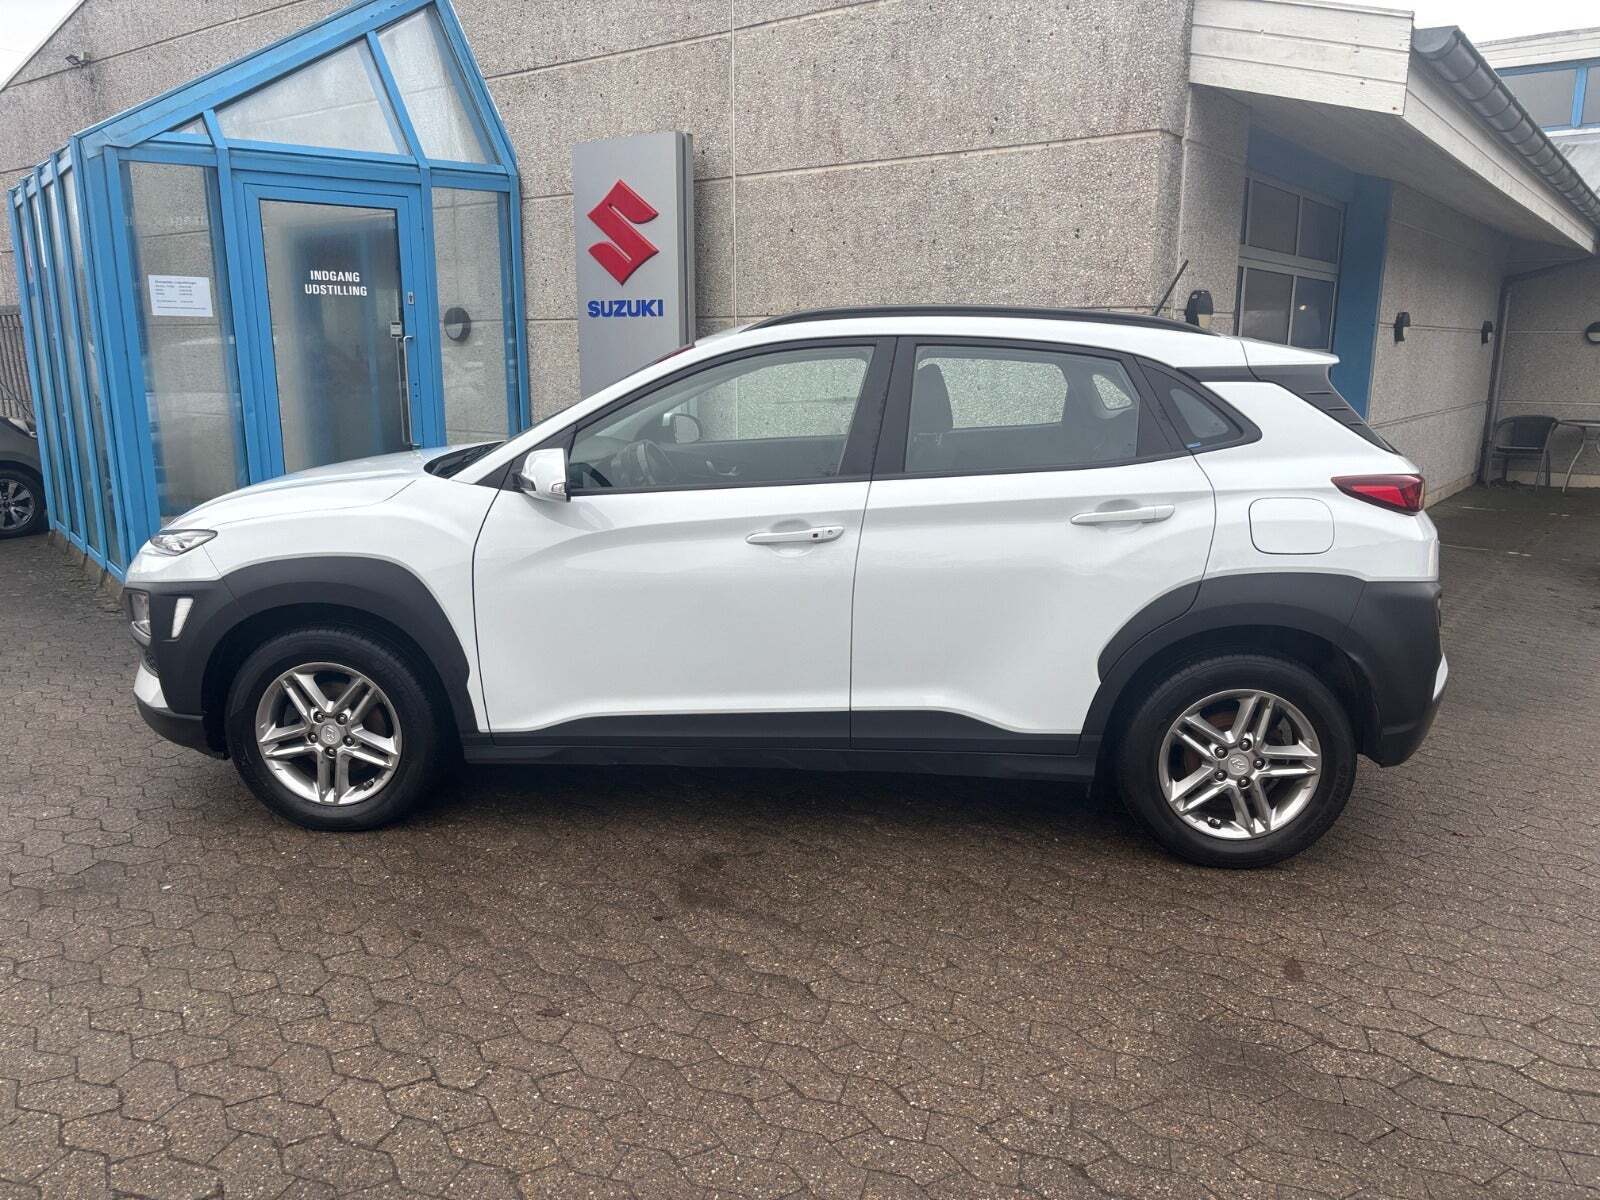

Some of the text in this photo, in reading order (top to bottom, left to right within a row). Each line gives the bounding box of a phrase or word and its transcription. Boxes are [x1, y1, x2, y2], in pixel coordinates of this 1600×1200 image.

[310, 270, 360, 282] INDGANG
[305, 284, 367, 296] UDSTILLING
[587, 299, 664, 317] SUZUKI
